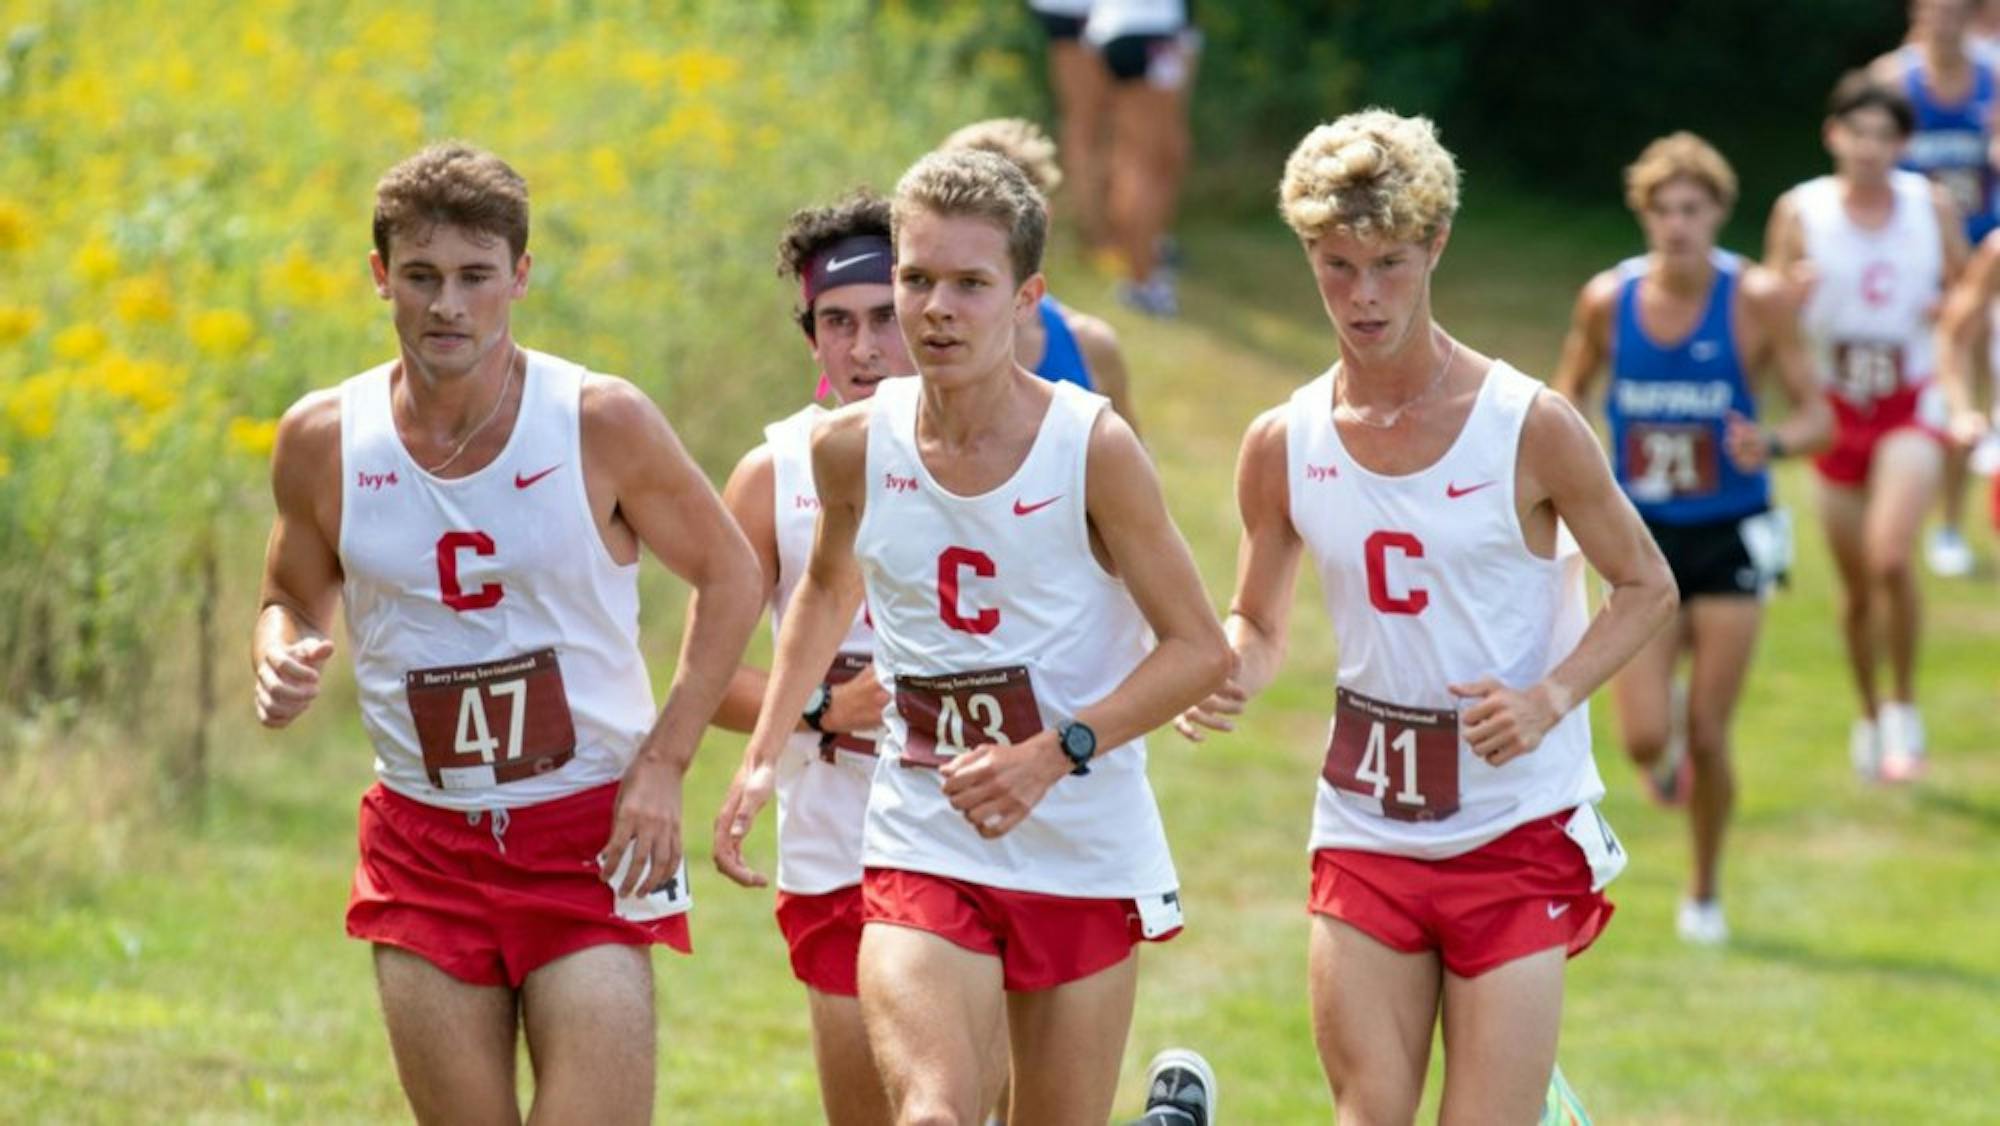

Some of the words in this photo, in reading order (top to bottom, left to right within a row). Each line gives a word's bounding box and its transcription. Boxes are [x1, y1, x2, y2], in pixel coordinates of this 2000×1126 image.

[358, 472, 384, 490] Ivy
[886, 474, 908, 492] Ivy
[1307, 464, 1327, 482] Ivy
[436, 531, 504, 612] C
[938, 545, 1000, 634] C
[1364, 531, 1428, 616] C
[478, 658, 536, 679] Invitational
[454, 678, 527, 763] 47
[934, 693, 1012, 756] 43
[1355, 721, 1426, 806] 41
